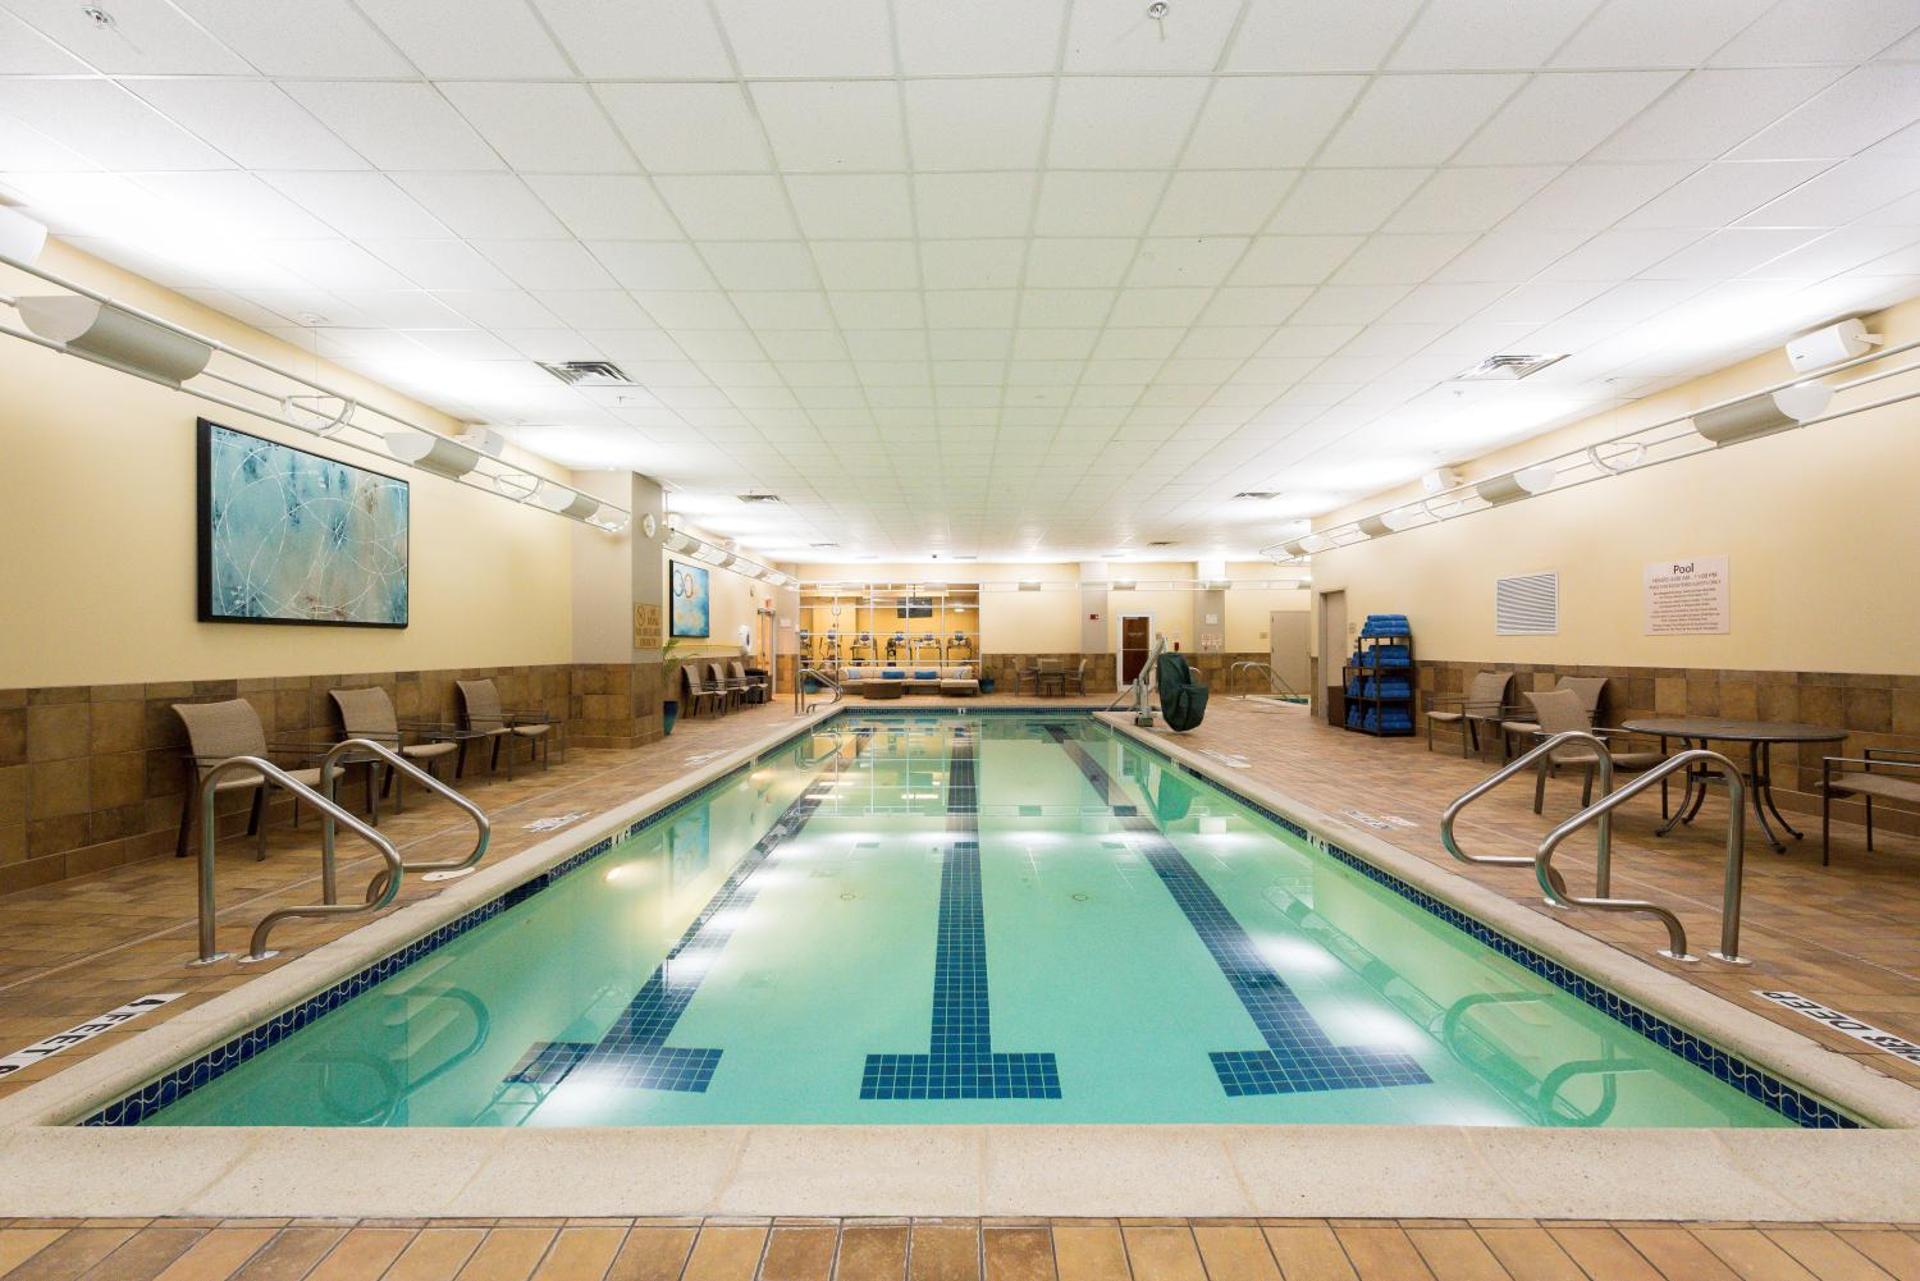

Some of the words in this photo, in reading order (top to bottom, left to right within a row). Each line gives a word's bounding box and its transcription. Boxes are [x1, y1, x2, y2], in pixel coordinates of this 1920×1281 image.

[1673, 562, 1694, 574] Pool
[1762, 992, 1872, 1031] DEEP
[22, 1012, 136, 1056] FEET
